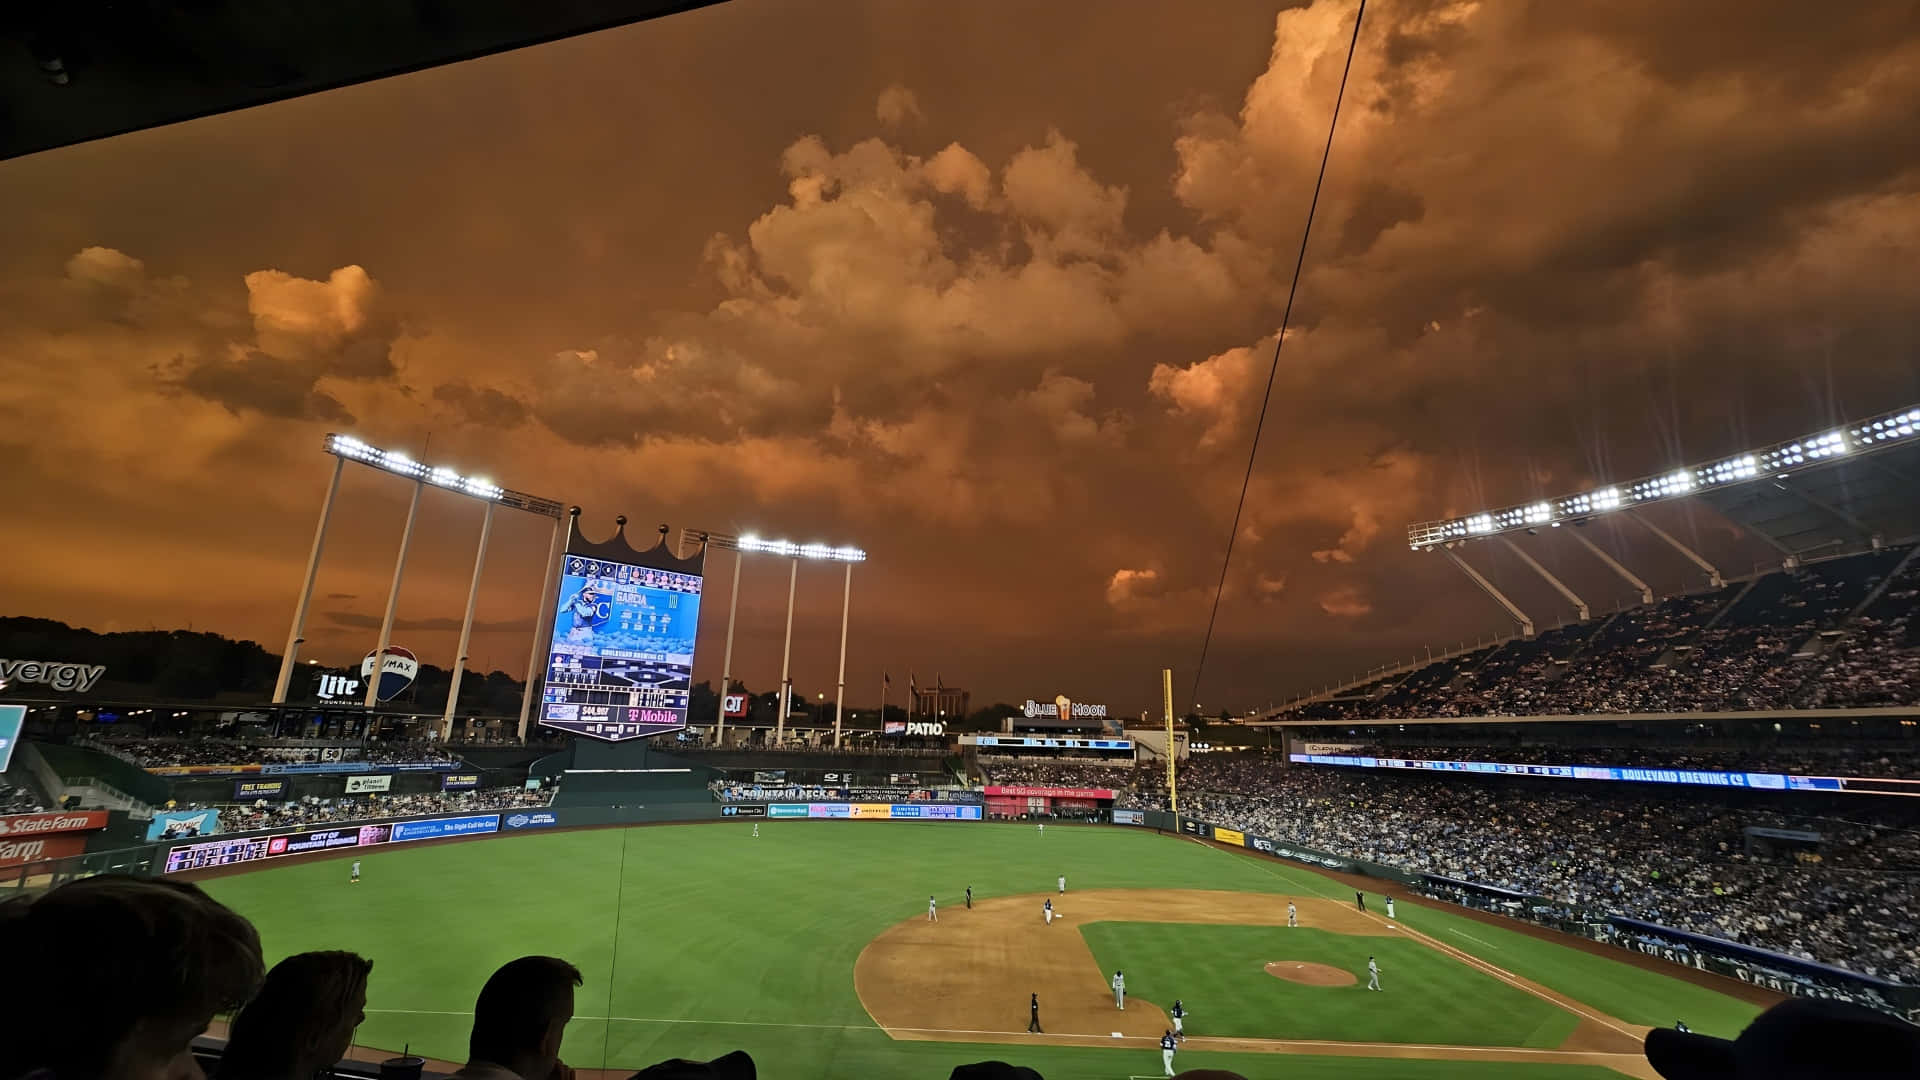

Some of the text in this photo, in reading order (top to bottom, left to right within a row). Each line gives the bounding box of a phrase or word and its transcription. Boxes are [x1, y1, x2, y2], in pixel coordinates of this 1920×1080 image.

[370, 661, 411, 672] R/MAX
[317, 674, 359, 699] Lite
[725, 695, 744, 712] QT
[1071, 703, 1106, 717] MOON
[640, 710, 678, 723] Mobile
[905, 722, 943, 736] PATIO
[1621, 769, 1678, 782] BOULEVARD
[1679, 772, 1729, 785] BREWING
[743, 790, 796, 800] FOUNTAIN
[1001, 787, 1015, 795] Best
[10, 817, 88, 833] StateFarm
[287, 840, 325, 851] FOUNTAIN
